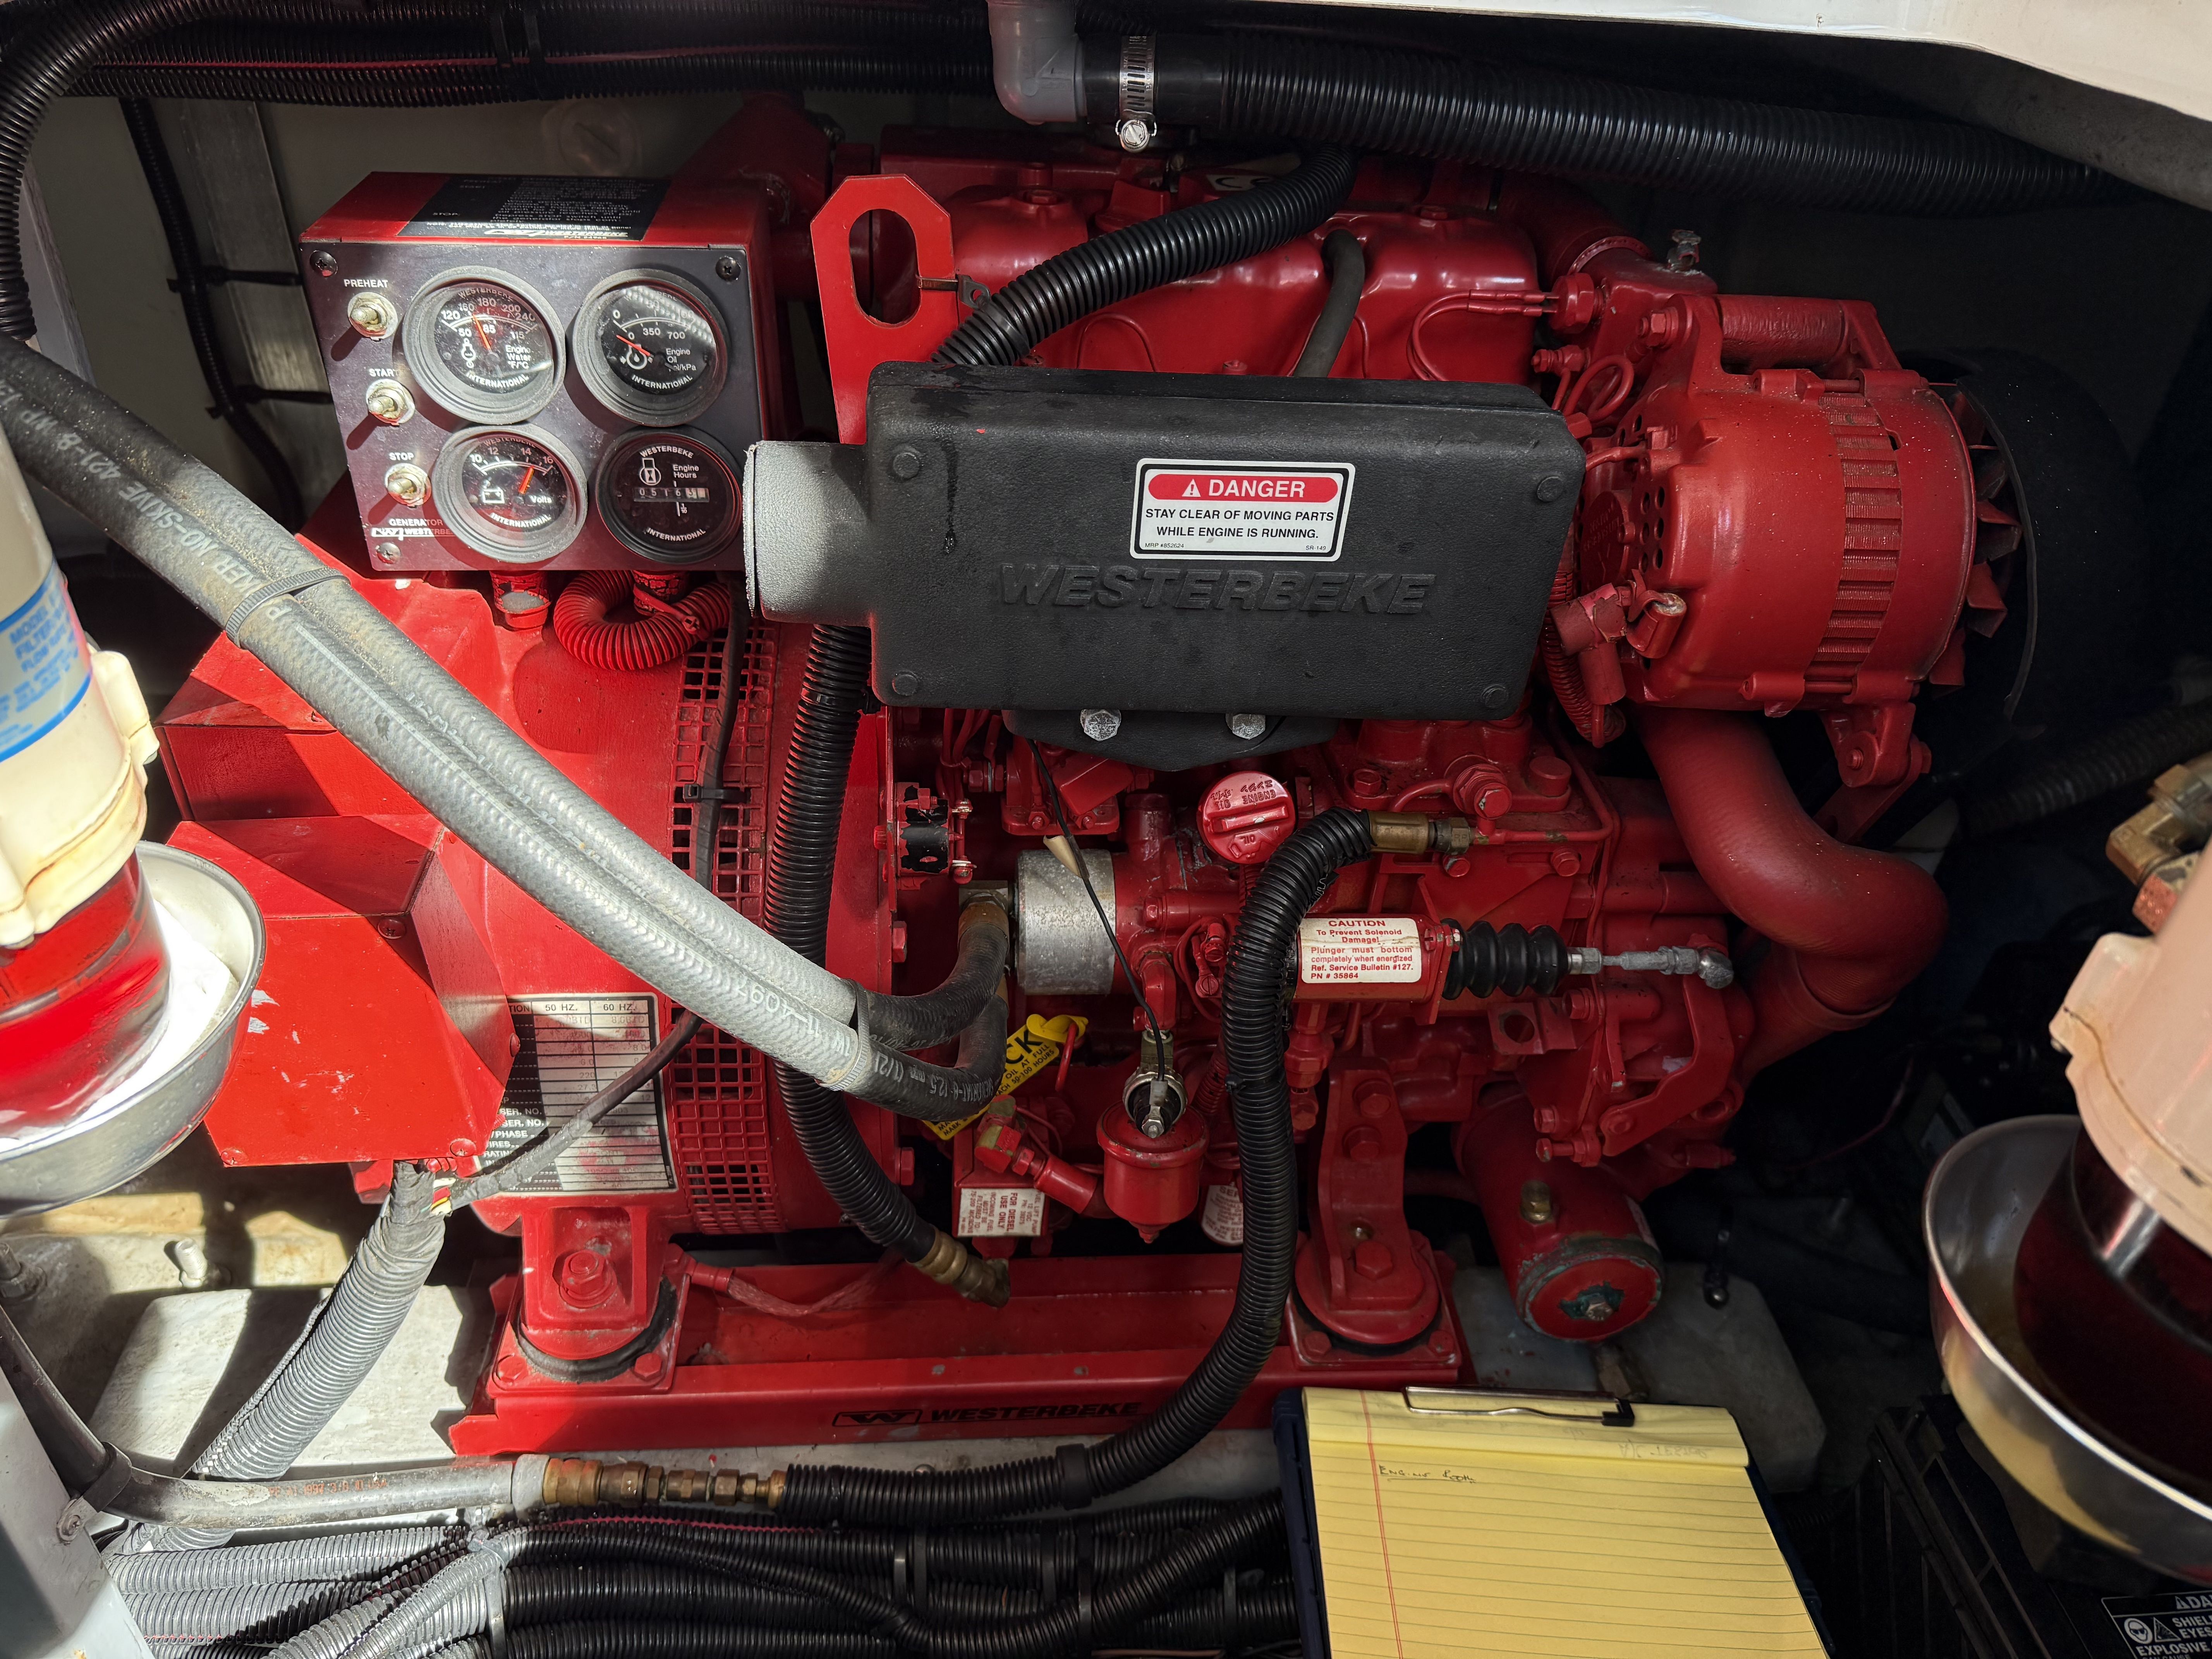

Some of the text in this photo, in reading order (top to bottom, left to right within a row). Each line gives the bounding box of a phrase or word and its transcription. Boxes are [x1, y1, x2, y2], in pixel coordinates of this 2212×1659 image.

[344, 279, 388, 288] PREHEAT
[441, 297, 536, 321] 120 160 180 200 240
[613, 309, 621, 319] 0
[459, 324, 525, 339] 50 85 115
[642, 328, 661, 336] 350
[667, 331, 685, 340] 700
[505, 345, 531, 354] Engine
[369, 368, 398, 377] START
[669, 364, 697, 372] i/kPa
[466, 372, 530, 388] INTERNATIONAL
[632, 374, 693, 389] INTERNATIONAL
[21, 409, 58, 431] WP
[57, 433, 121, 480] 421-8
[389, 452, 414, 461] STOP
[469, 447, 554, 464] 10 12 14 16
[639, 445, 694, 459] WESTERBEKE
[1209, 479, 1305, 498] DANGER
[529, 495, 552, 503] Volts
[118, 481, 211, 557] NO-SKIVE
[490, 512, 551, 527] INTERNATIONAL
[1146, 508, 1334, 521] STAY CLEAR OF MOVING PARTS
[389, 518, 443, 527] GENERATOR
[647, 527, 706, 542] INTERNATIONAL
[1157, 526, 1319, 539] WHILE ENGINE IS RUNNING.
[998, 563, 1437, 614] WESTERBEKE
[1215, 789, 1276, 810] ENGINE OIL
[1240, 834, 1255, 845] OIL
[1311, 947, 1345, 955] Plunger
[1311, 955, 1352, 963] completely
[1376, 955, 1413, 963] energized
[1005, 1044, 1050, 1079] OIL AT FULL
[943, 1122, 962, 1136] MARK
[997, 1084, 1011, 1095] ACH
[1012, 1066, 1033, 1084] 50-100
[1033, 1049, 1055, 1067] HOURS
[487, 1140, 511, 1149] IRES
[997, 1195, 1008, 1229] USE ONLY
[1007, 1192, 1018, 1232] FOR DIESEL
[931, 1402, 1142, 1421] WESTERBEKE
[2178, 1626, 2212, 1639] EYES
[2135, 1642, 2211, 1657] EXPLOSIVE
